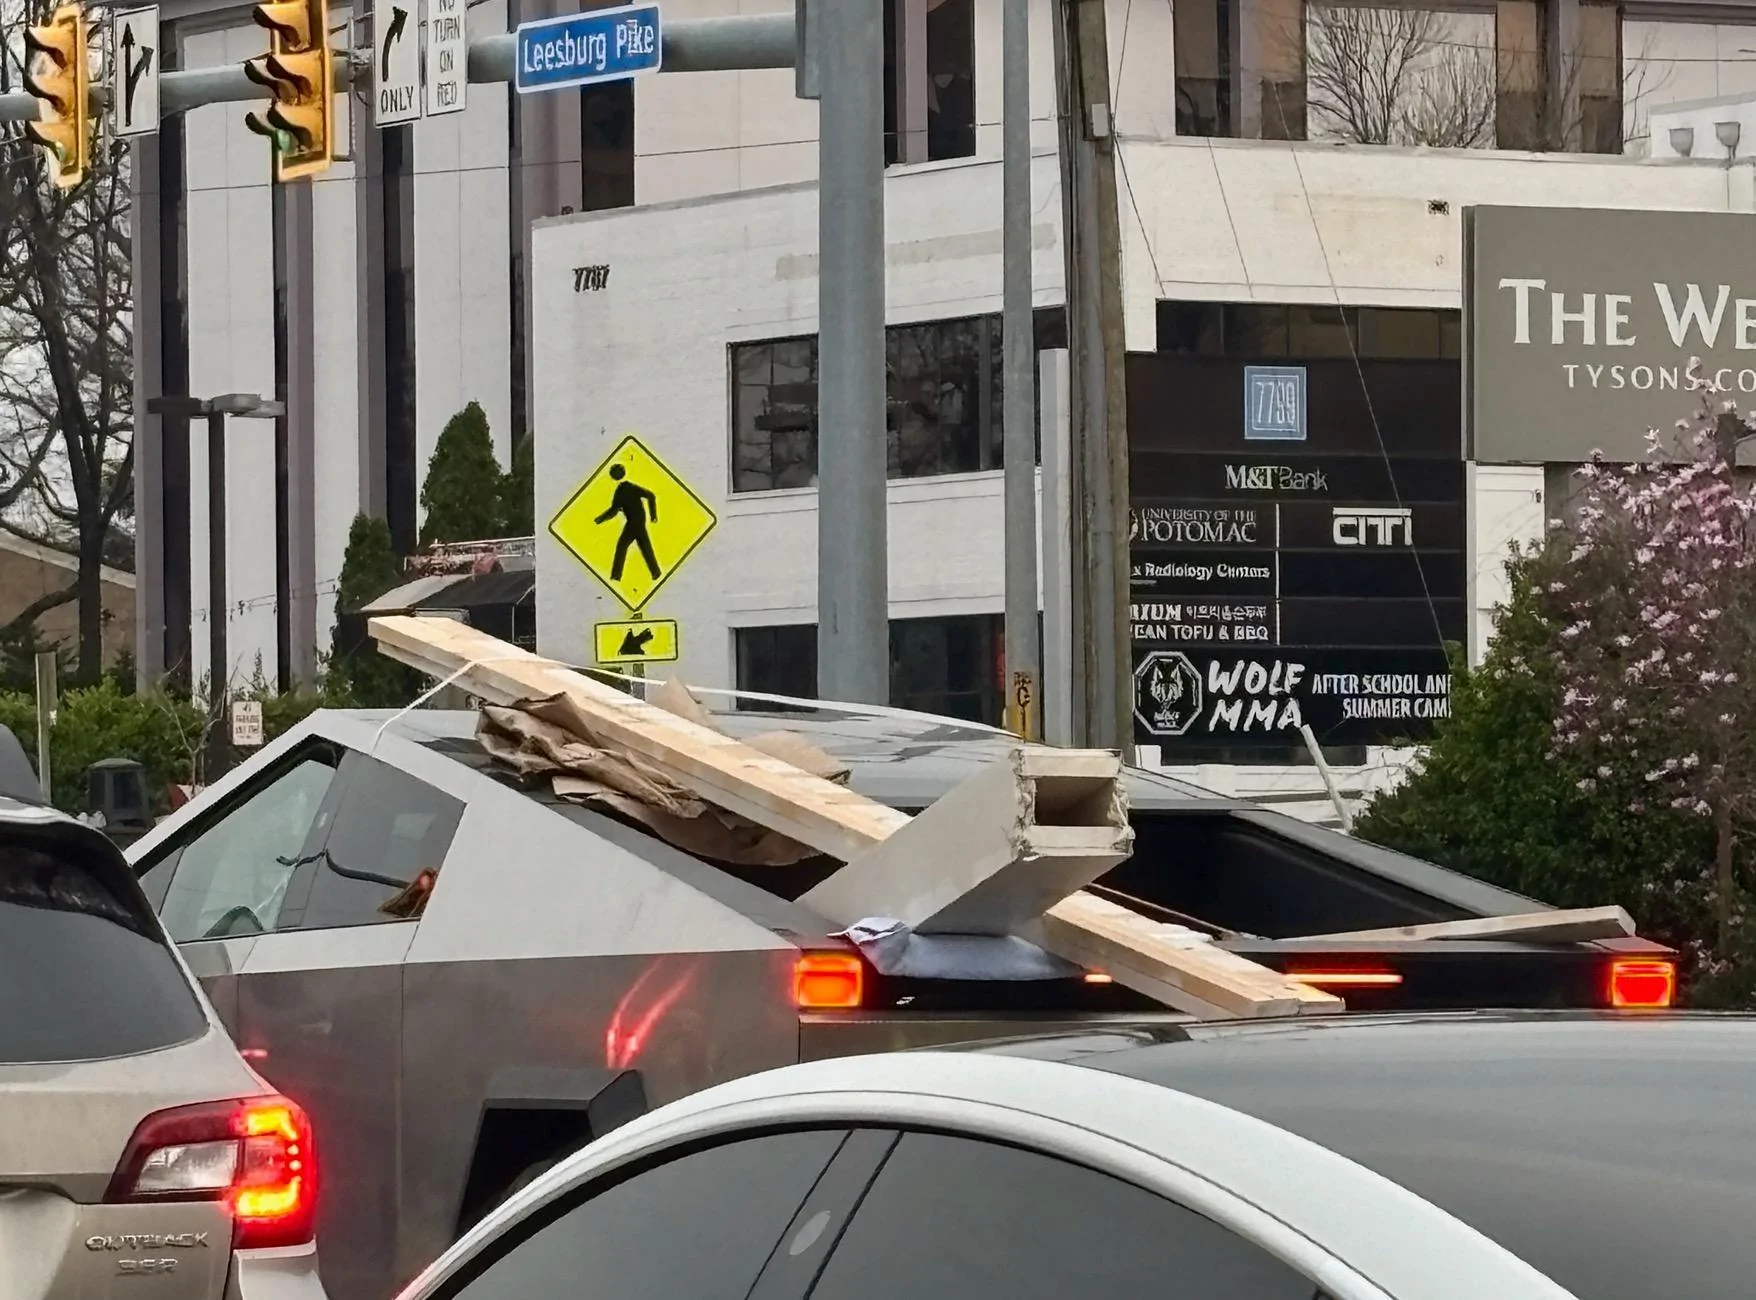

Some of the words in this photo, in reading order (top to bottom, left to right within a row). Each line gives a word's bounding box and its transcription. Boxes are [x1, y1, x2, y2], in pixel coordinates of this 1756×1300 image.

[433, 15, 460, 43] TURN
[523, 29, 606, 73] Leesburg
[616, 20, 654, 58] Pike
[439, 48, 454, 73] ON
[381, 86, 414, 114] ONLY
[437, 80, 457, 107] RED
[1498, 278, 1637, 346] THE
[1563, 364, 1702, 391] TYSONS
[1225, 464, 1278, 490] M&T
[1279, 466, 1328, 491] Bank
[1141, 519, 1257, 542] POTOMAC
[1145, 562, 1213, 581] Radiology
[1171, 625, 1213, 640] TOFU
[1234, 625, 1268, 640] BBQ
[1208, 659, 1306, 696] WOLF
[1312, 673, 1360, 694] AFTER
[1362, 673, 1424, 694] SCHOOL
[1208, 697, 1302, 732] MMA
[1342, 697, 1412, 718] SUMMER
[1414, 697, 1451, 718] CAM
